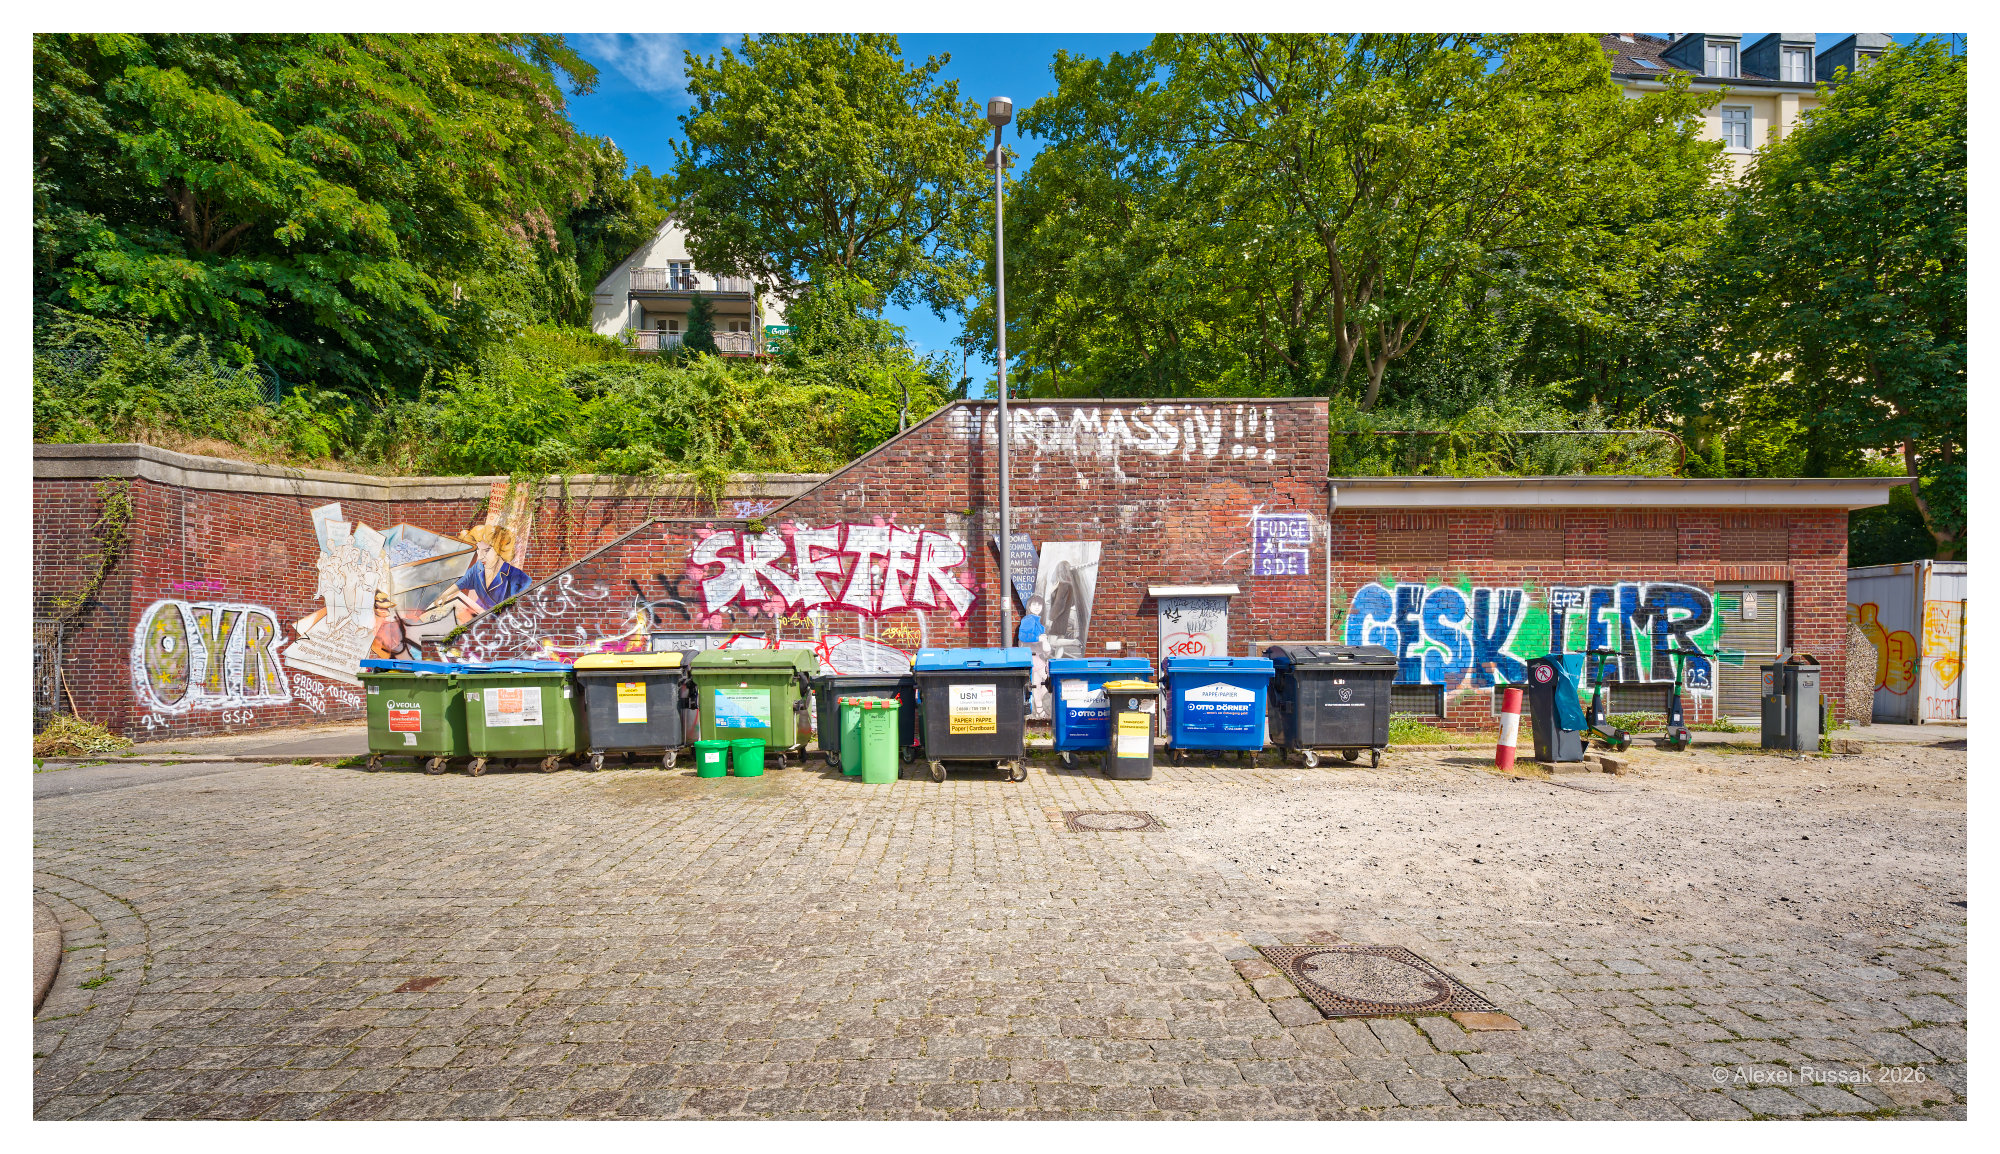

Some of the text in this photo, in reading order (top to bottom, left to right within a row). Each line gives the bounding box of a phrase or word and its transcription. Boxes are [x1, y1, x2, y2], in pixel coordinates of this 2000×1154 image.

[1261, 520, 1306, 537] FUDGE
[293, 673, 325, 698] GABOR
[1216, 703, 1249, 711] DÖRNER
